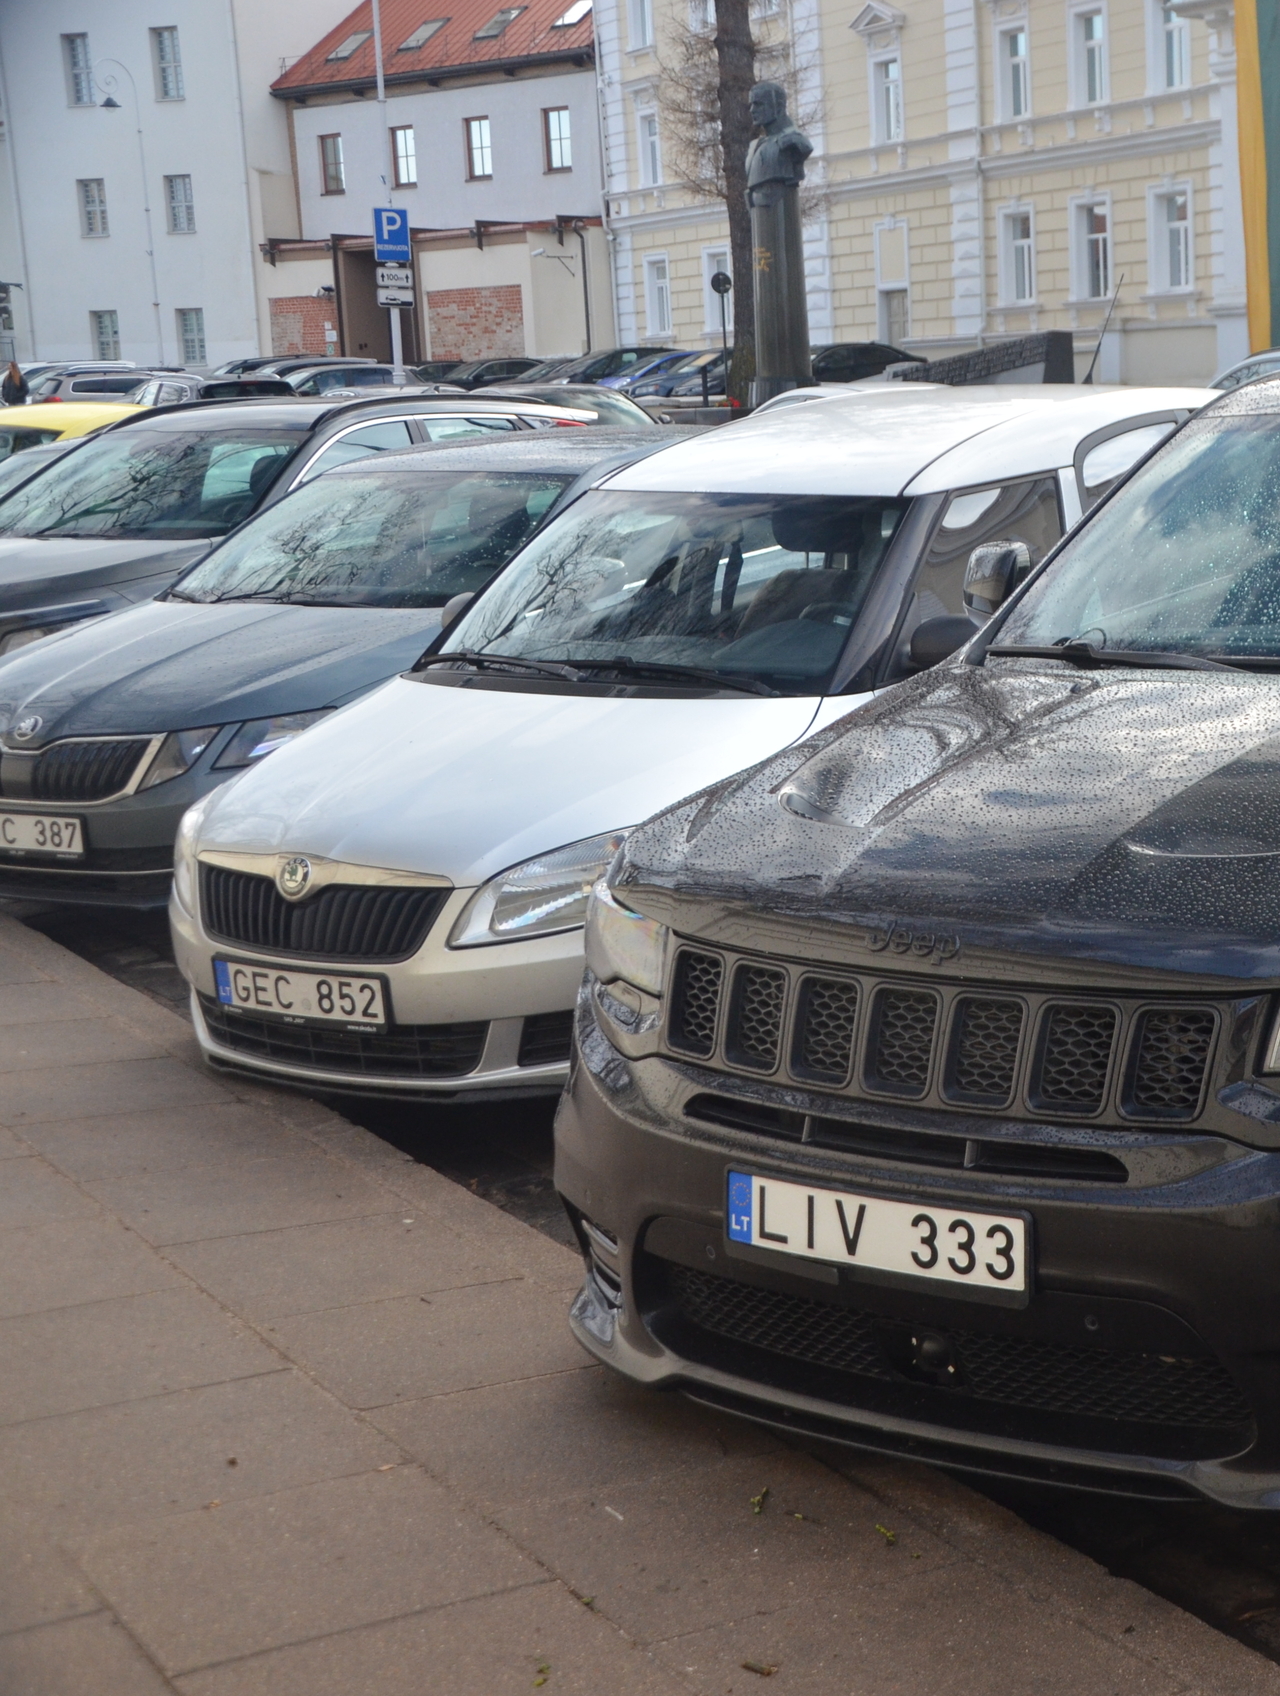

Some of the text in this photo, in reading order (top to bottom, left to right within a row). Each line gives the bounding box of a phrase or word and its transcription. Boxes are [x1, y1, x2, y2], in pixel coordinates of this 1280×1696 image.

[381, 211, 402, 240] P
[34, 819, 77, 848] 387
[865, 920, 960, 966] Jeep
[219, 986, 232, 996] LT
[233, 968, 379, 1018] GEC 852
[731, 1213, 750, 1232] LT
[759, 1185, 1015, 1281] LIV 333
